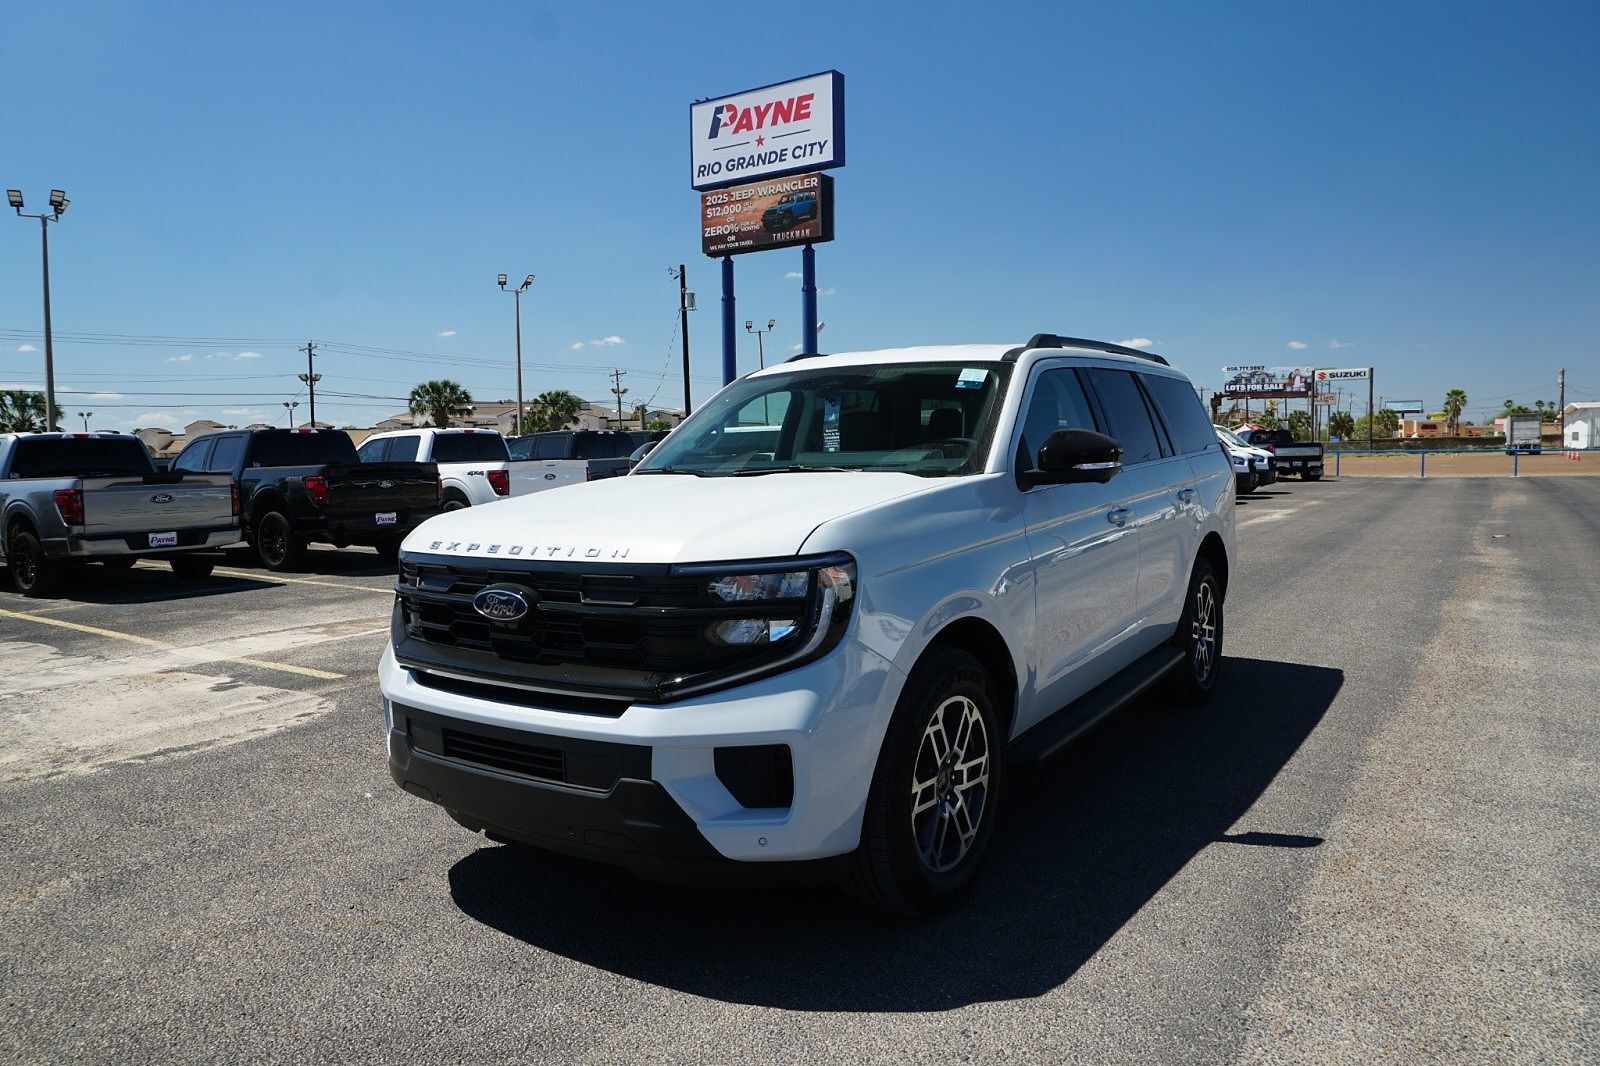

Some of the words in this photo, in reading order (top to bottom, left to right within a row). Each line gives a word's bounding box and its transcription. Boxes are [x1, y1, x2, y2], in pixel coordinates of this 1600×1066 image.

[708, 93, 815, 139] PAYNE
[697, 162, 721, 178] RIO
[726, 148, 788, 172] GRANDE
[792, 140, 828, 159] CITY
[706, 193, 728, 206] 2025
[730, 189, 755, 202] JEEP
[757, 177, 818, 197] WRANGLER
[706, 204, 742, 218] $12,000
[704, 224, 739, 237] ZERO%
[772, 229, 810, 241] TRUCKMAN
[150, 536, 175, 544] PAYNE
[429, 541, 630, 558] EXPEDITION
[483, 592, 516, 616] Ford
